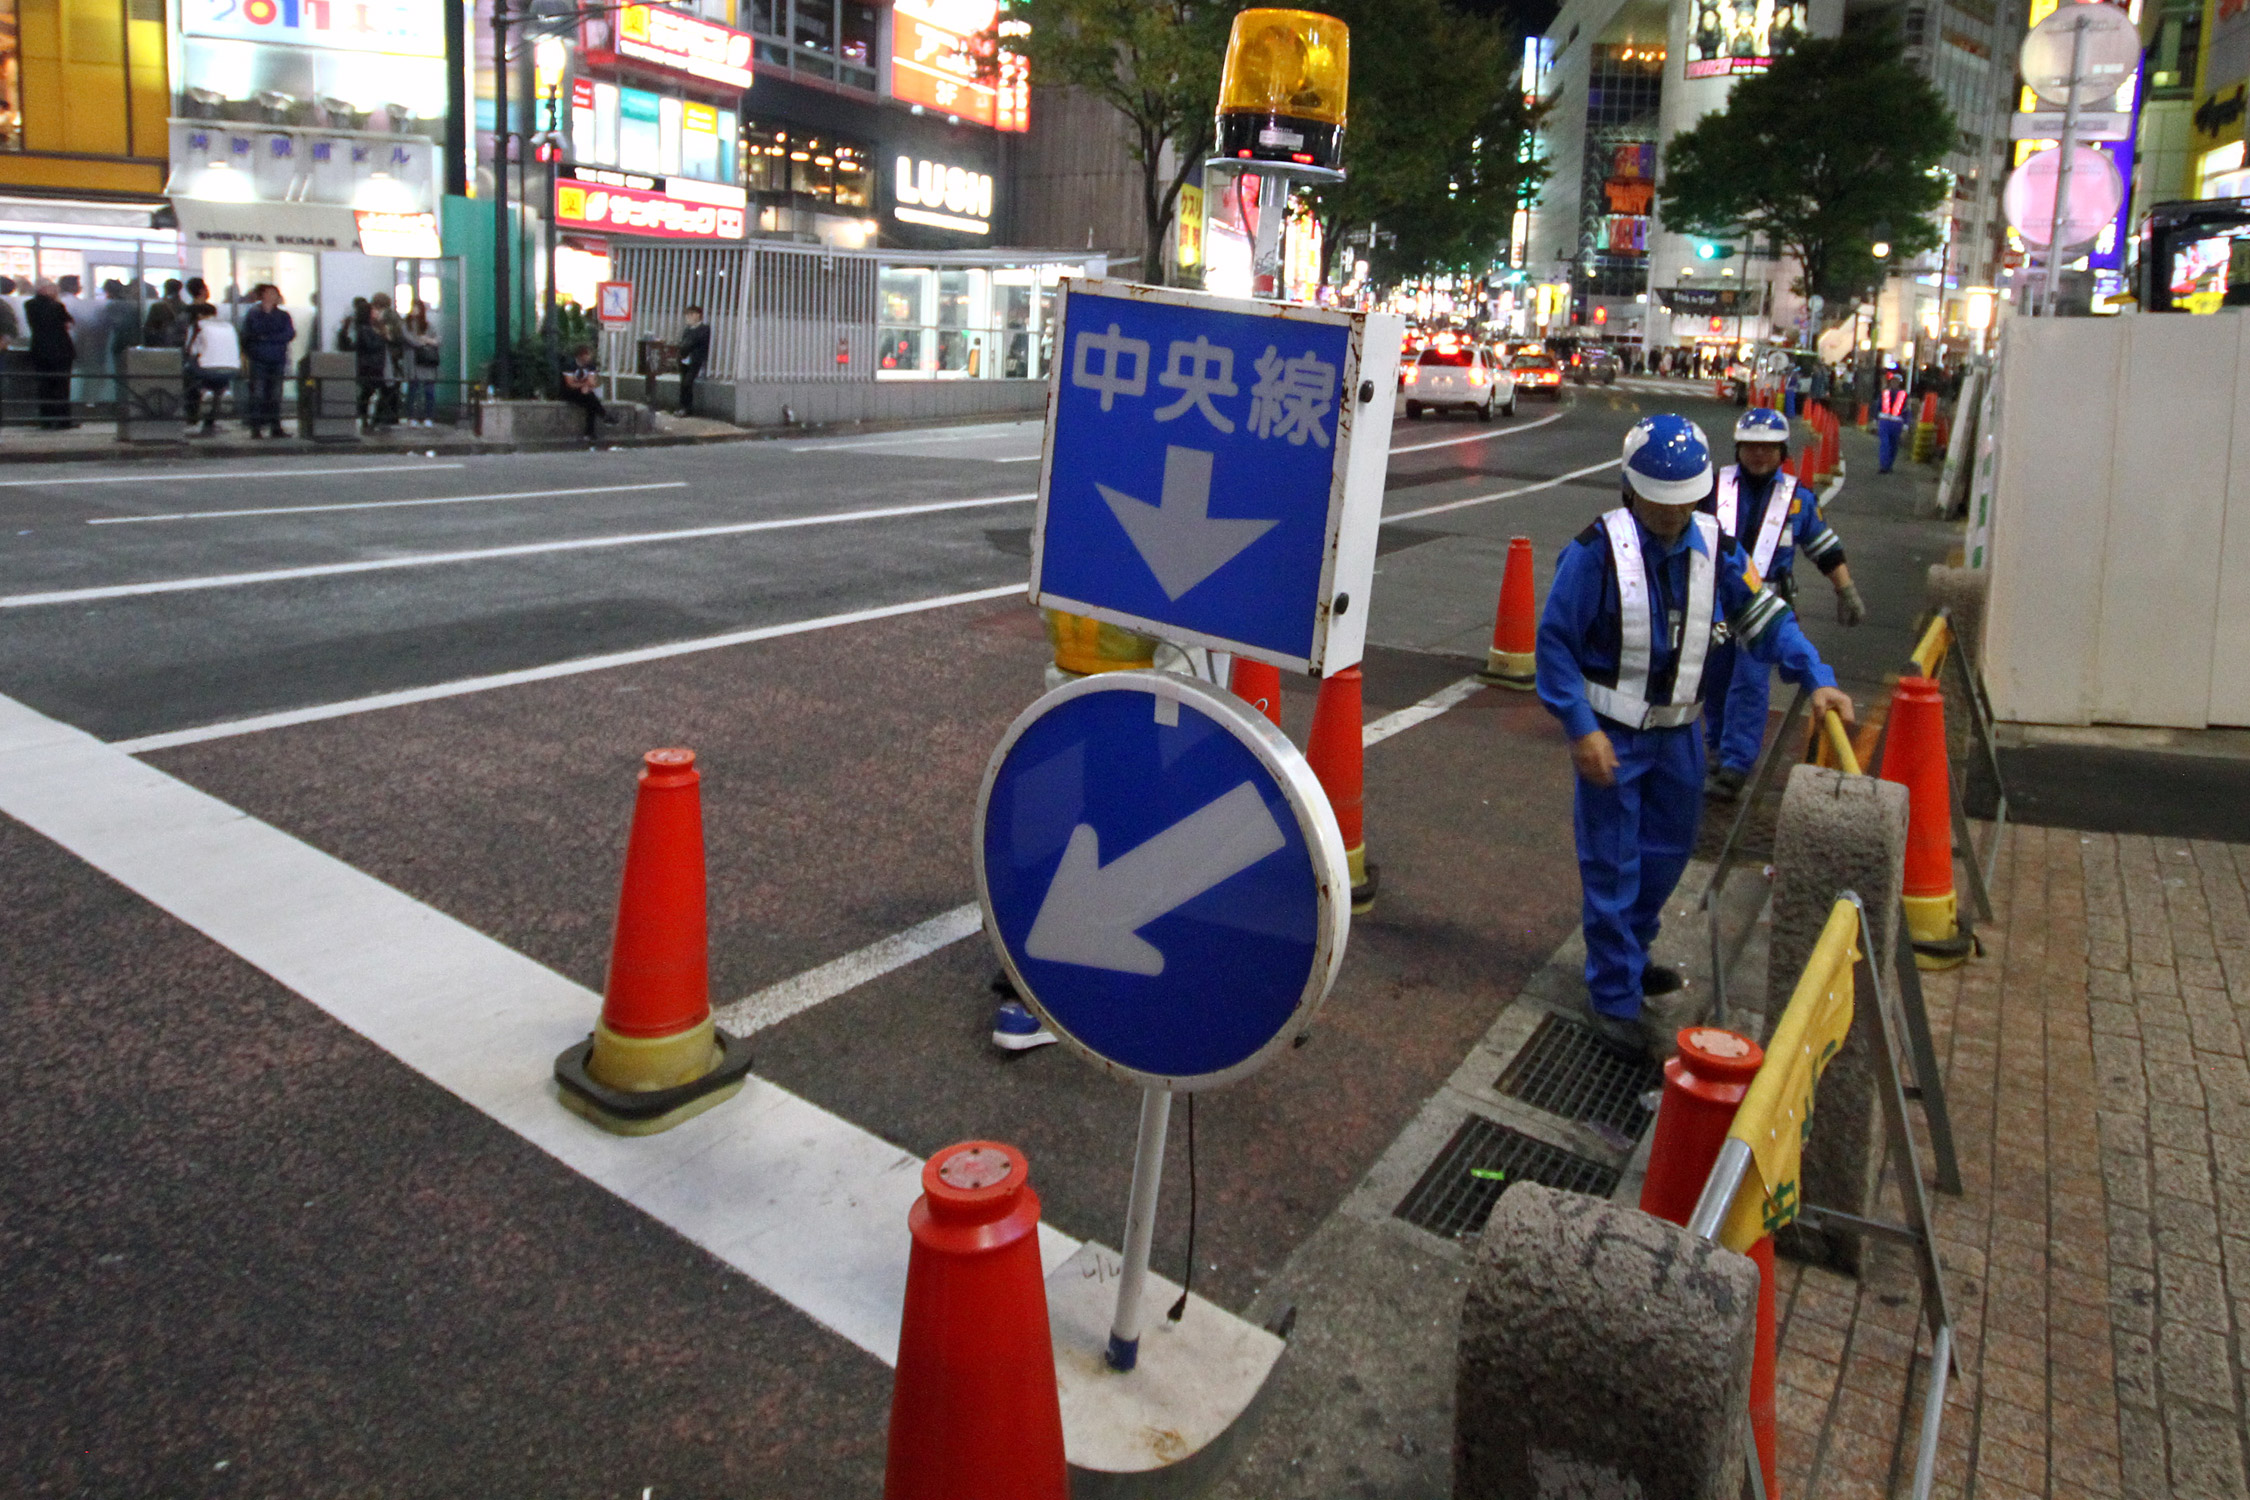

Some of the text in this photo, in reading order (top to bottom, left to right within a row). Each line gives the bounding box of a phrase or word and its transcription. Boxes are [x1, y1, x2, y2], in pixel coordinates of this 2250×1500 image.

[936, 80, 958, 106] 3F
[895, 155, 994, 219] LUSH
[196, 231, 266, 244] SHIBUYA
[1072, 322, 1338, 450] 中央線
